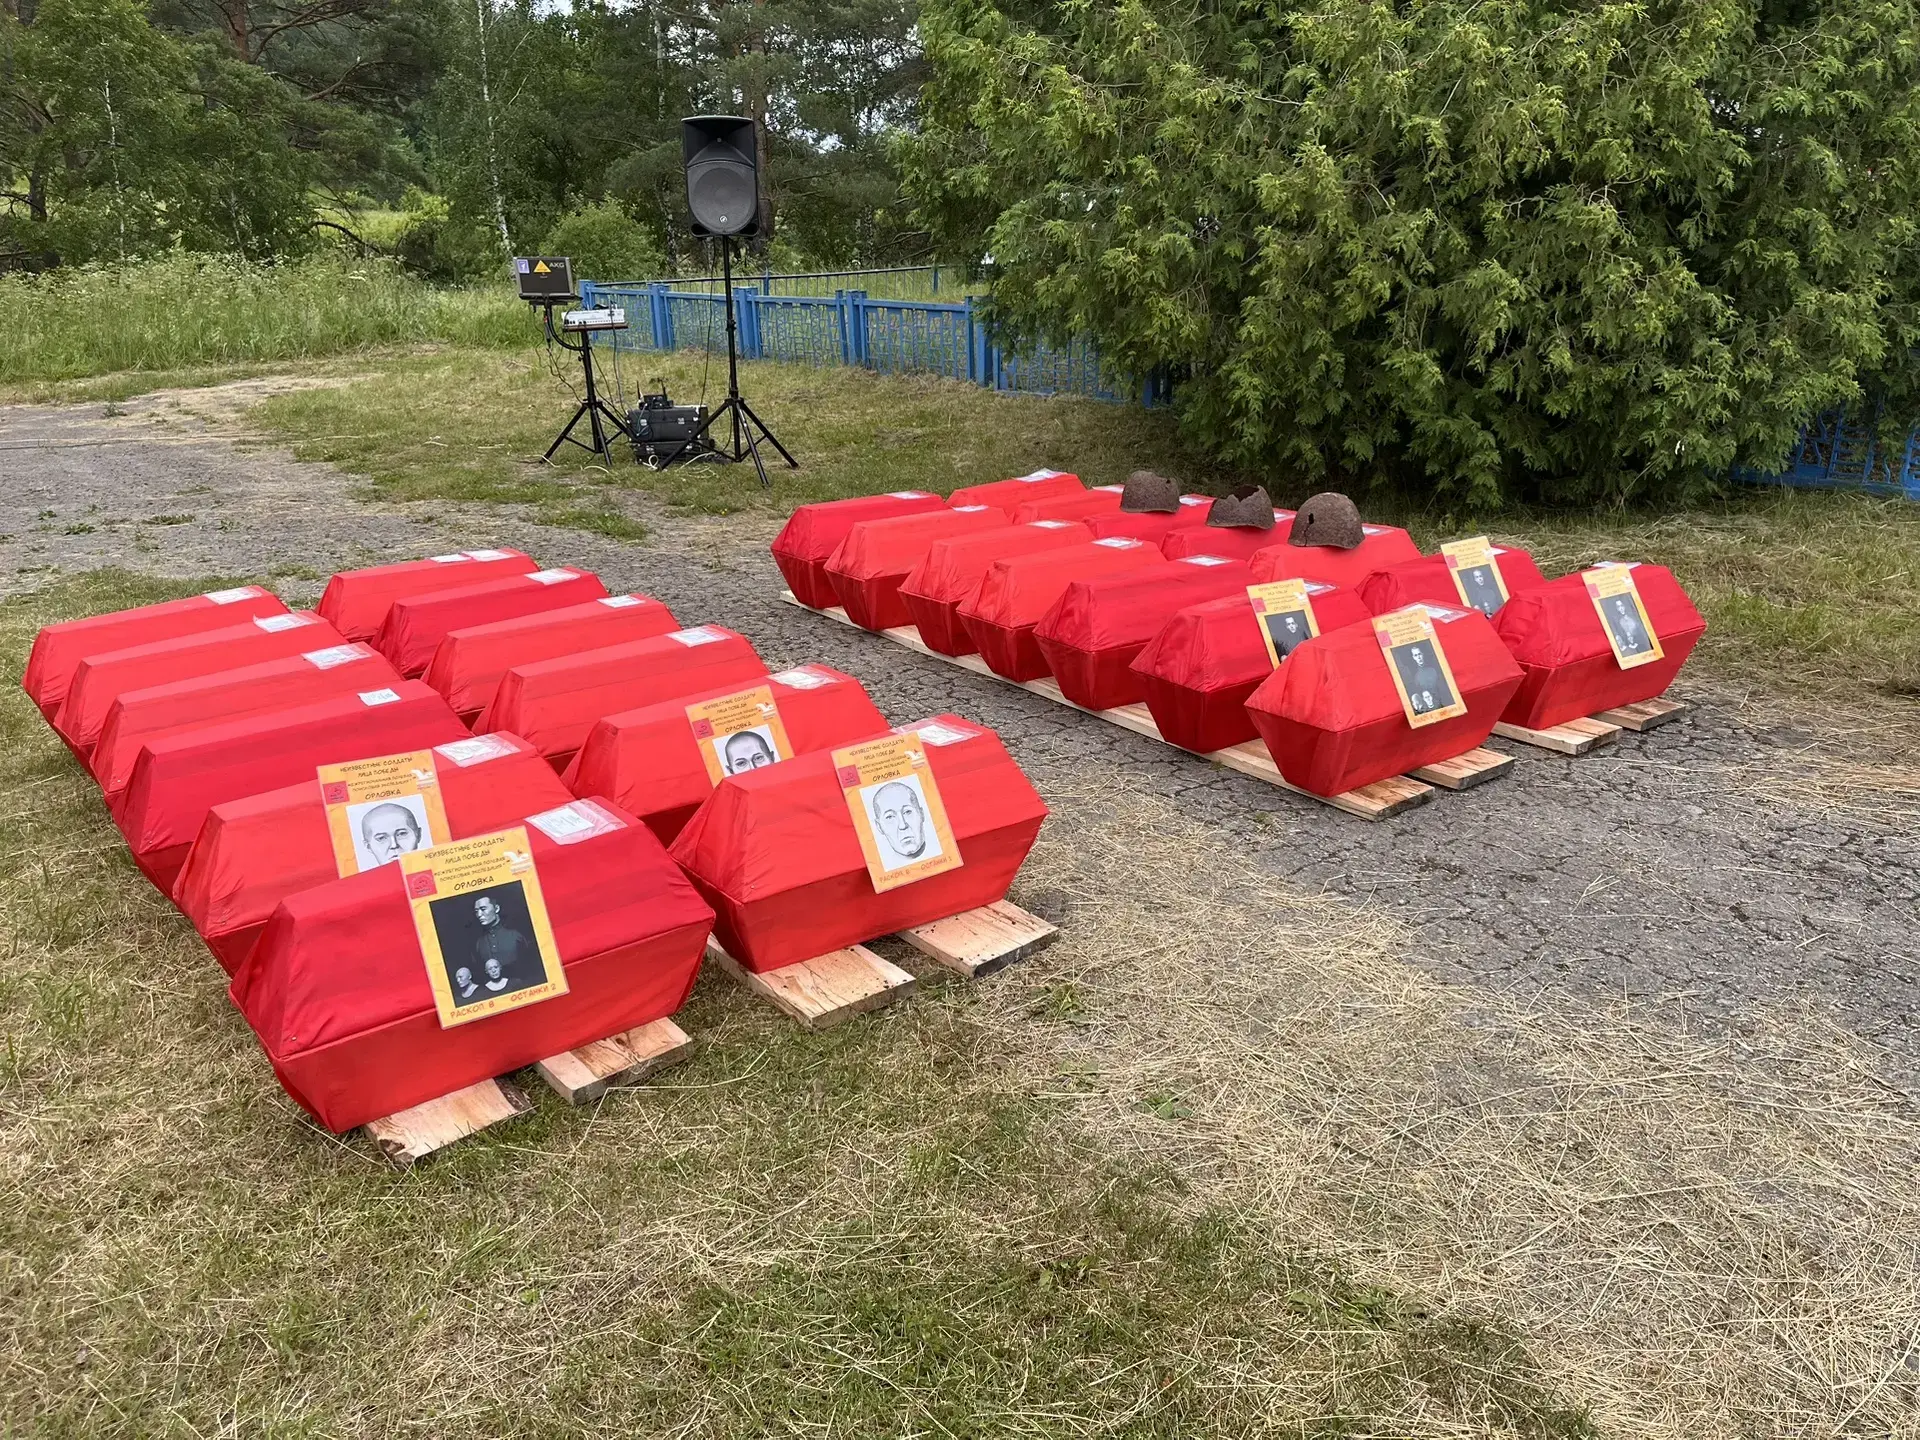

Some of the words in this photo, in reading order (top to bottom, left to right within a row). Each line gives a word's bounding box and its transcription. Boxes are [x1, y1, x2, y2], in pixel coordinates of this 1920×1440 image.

[725, 721, 752, 733] ОРЛОВКА
[383, 757, 413, 766] СОЛДАТЫ
[374, 767, 399, 776] ПОБЕДЫ
[872, 769, 901, 782] ОРЛОВКА
[364, 788, 402, 800] ОРЛОВКА
[424, 843, 470, 859] НЕИЗВЕСТНЫЕ
[472, 836, 505, 849] СОЛДАТЫ
[444, 856, 461, 864] ЛИЦА
[462, 849, 491, 860] ПОБЕДЫ
[453, 875, 495, 891] ОРЛОВКА
[450, 1003, 485, 1018] РАСКОП
[510, 985, 549, 1002] ОСТАНКИ
